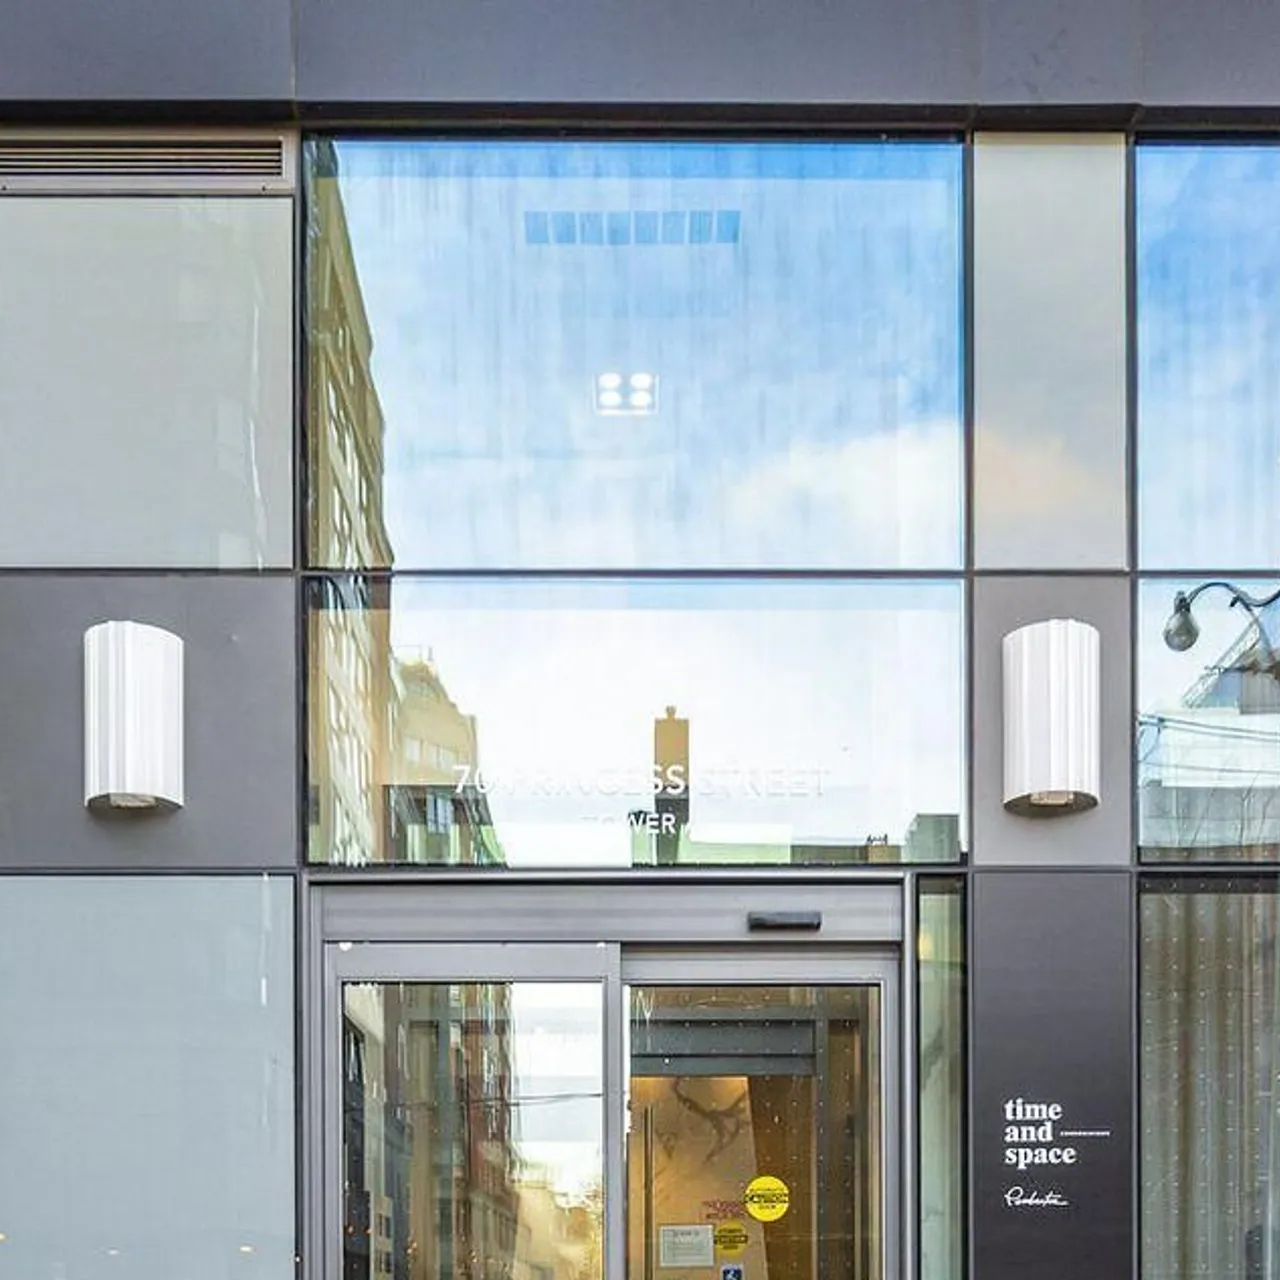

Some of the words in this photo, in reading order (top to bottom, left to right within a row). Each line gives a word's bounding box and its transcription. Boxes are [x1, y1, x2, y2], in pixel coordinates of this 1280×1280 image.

[1004, 1097, 1063, 1121] time
[1004, 1121, 1054, 1143] and
[1004, 1147, 1077, 1170] space
